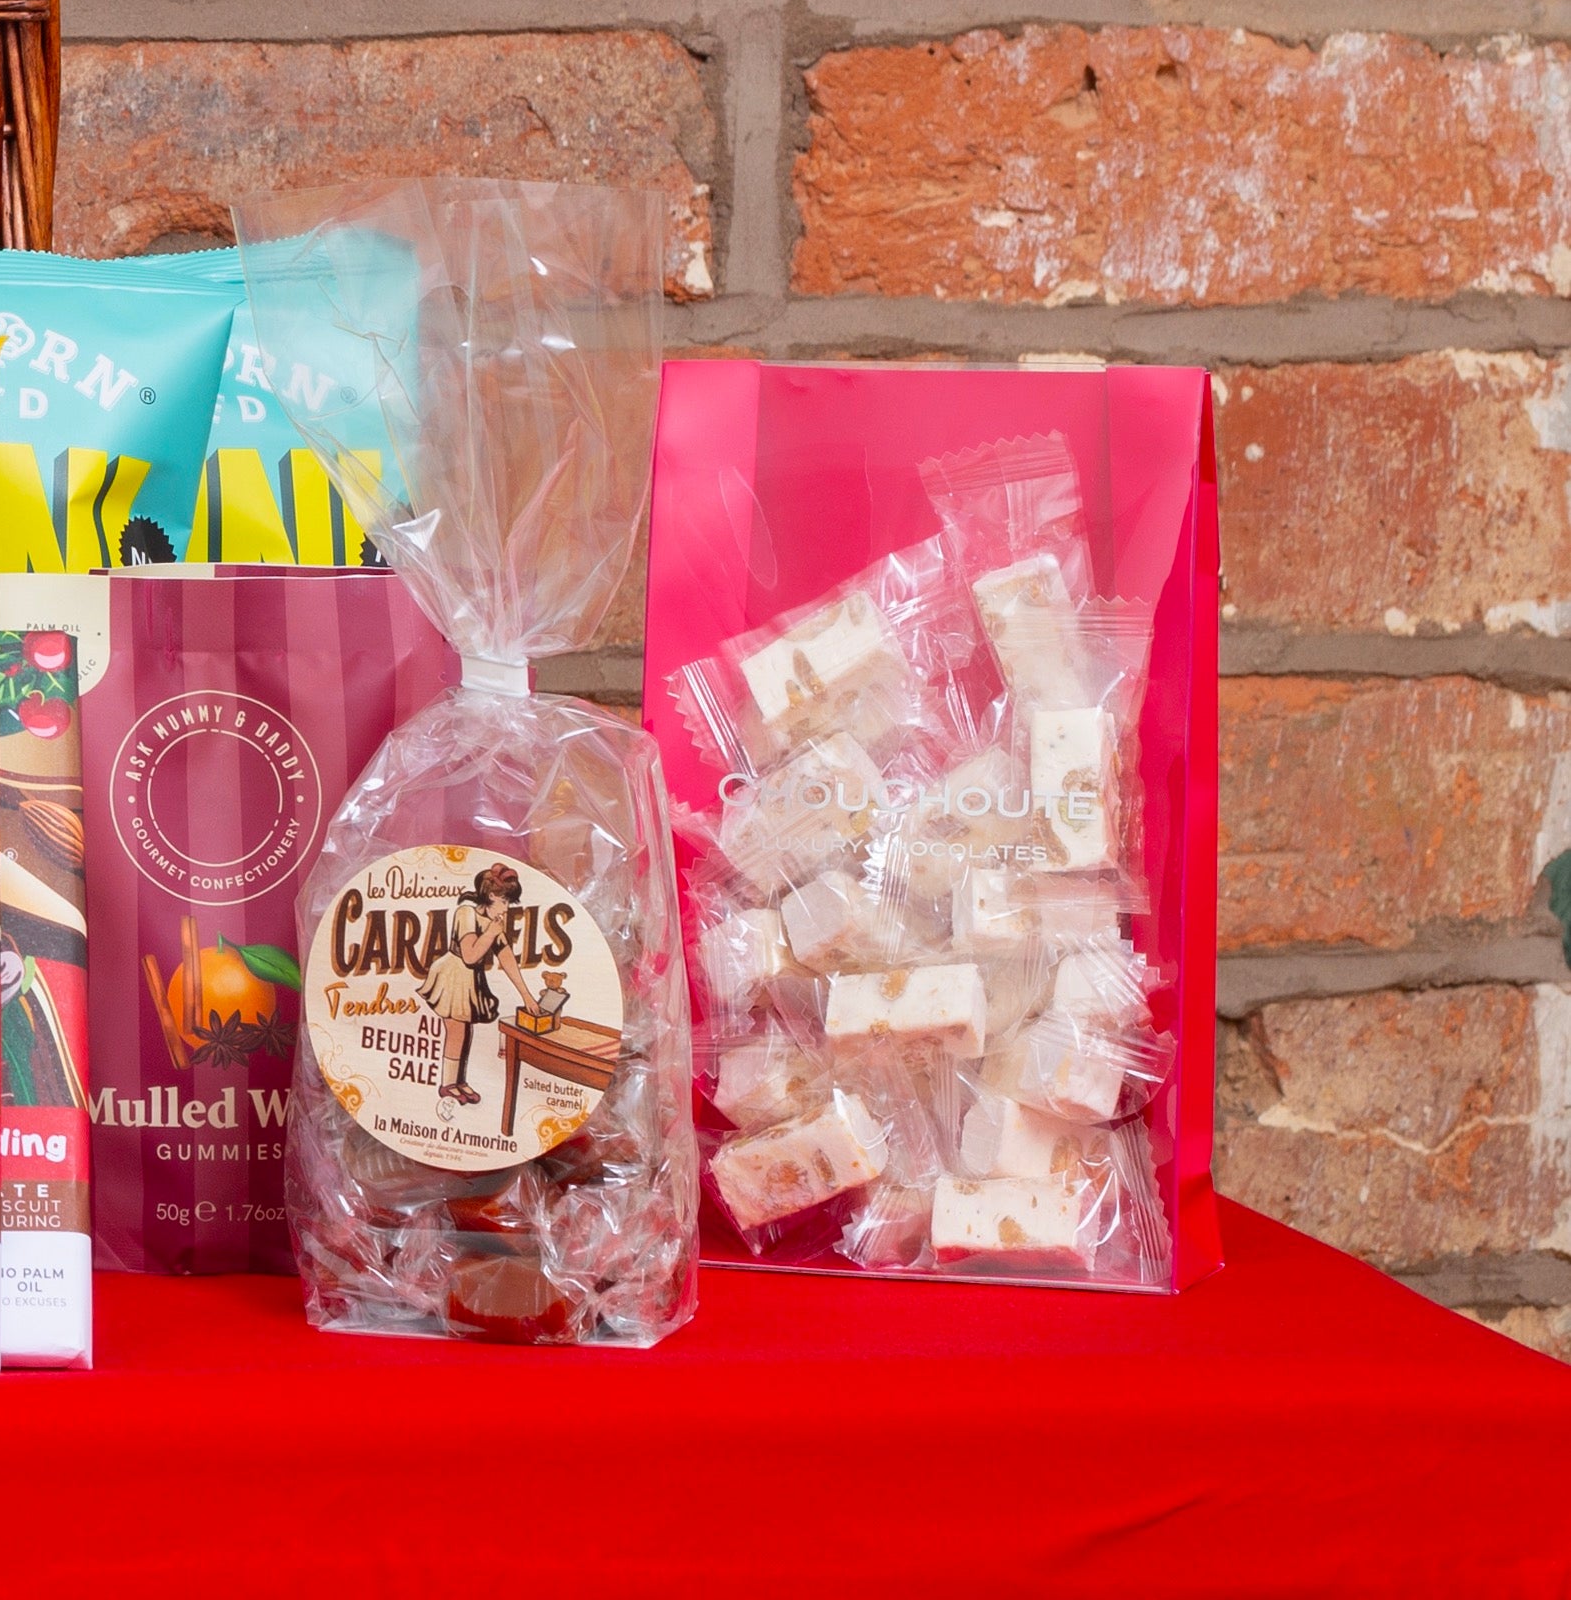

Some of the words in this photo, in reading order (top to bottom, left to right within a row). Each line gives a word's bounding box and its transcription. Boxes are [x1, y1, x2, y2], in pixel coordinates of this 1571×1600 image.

[124, 741, 155, 783] ASK
[152, 704, 223, 741] MUMMY
[233, 710, 247, 729] &
[254, 720, 306, 782] DADDY
[716, 771, 1099, 822] CHOUCHOUTE
[130, 816, 188, 882] GOURMET
[189, 816, 302, 891] CONFECTIONERY
[365, 870, 386, 900] les
[329, 887, 577, 981] CARAELS
[323, 980, 423, 1021] Tendres
[417, 1014, 443, 1038] AU
[360, 1025, 443, 1062] BEURRE
[387, 1056, 440, 1086] SALÉ
[522, 1076, 553, 1095] Salted
[553, 1079, 586, 1099] butter
[87, 1084, 240, 1130] Mulled
[545, 1096, 585, 1111] caramel
[373, 1113, 388, 1133] la
[389, 1116, 439, 1141] Maison
[155, 1142, 284, 1162] GUMMIES
[155, 1202, 192, 1226] 50g
[224, 1204, 287, 1223] 1.76oz
